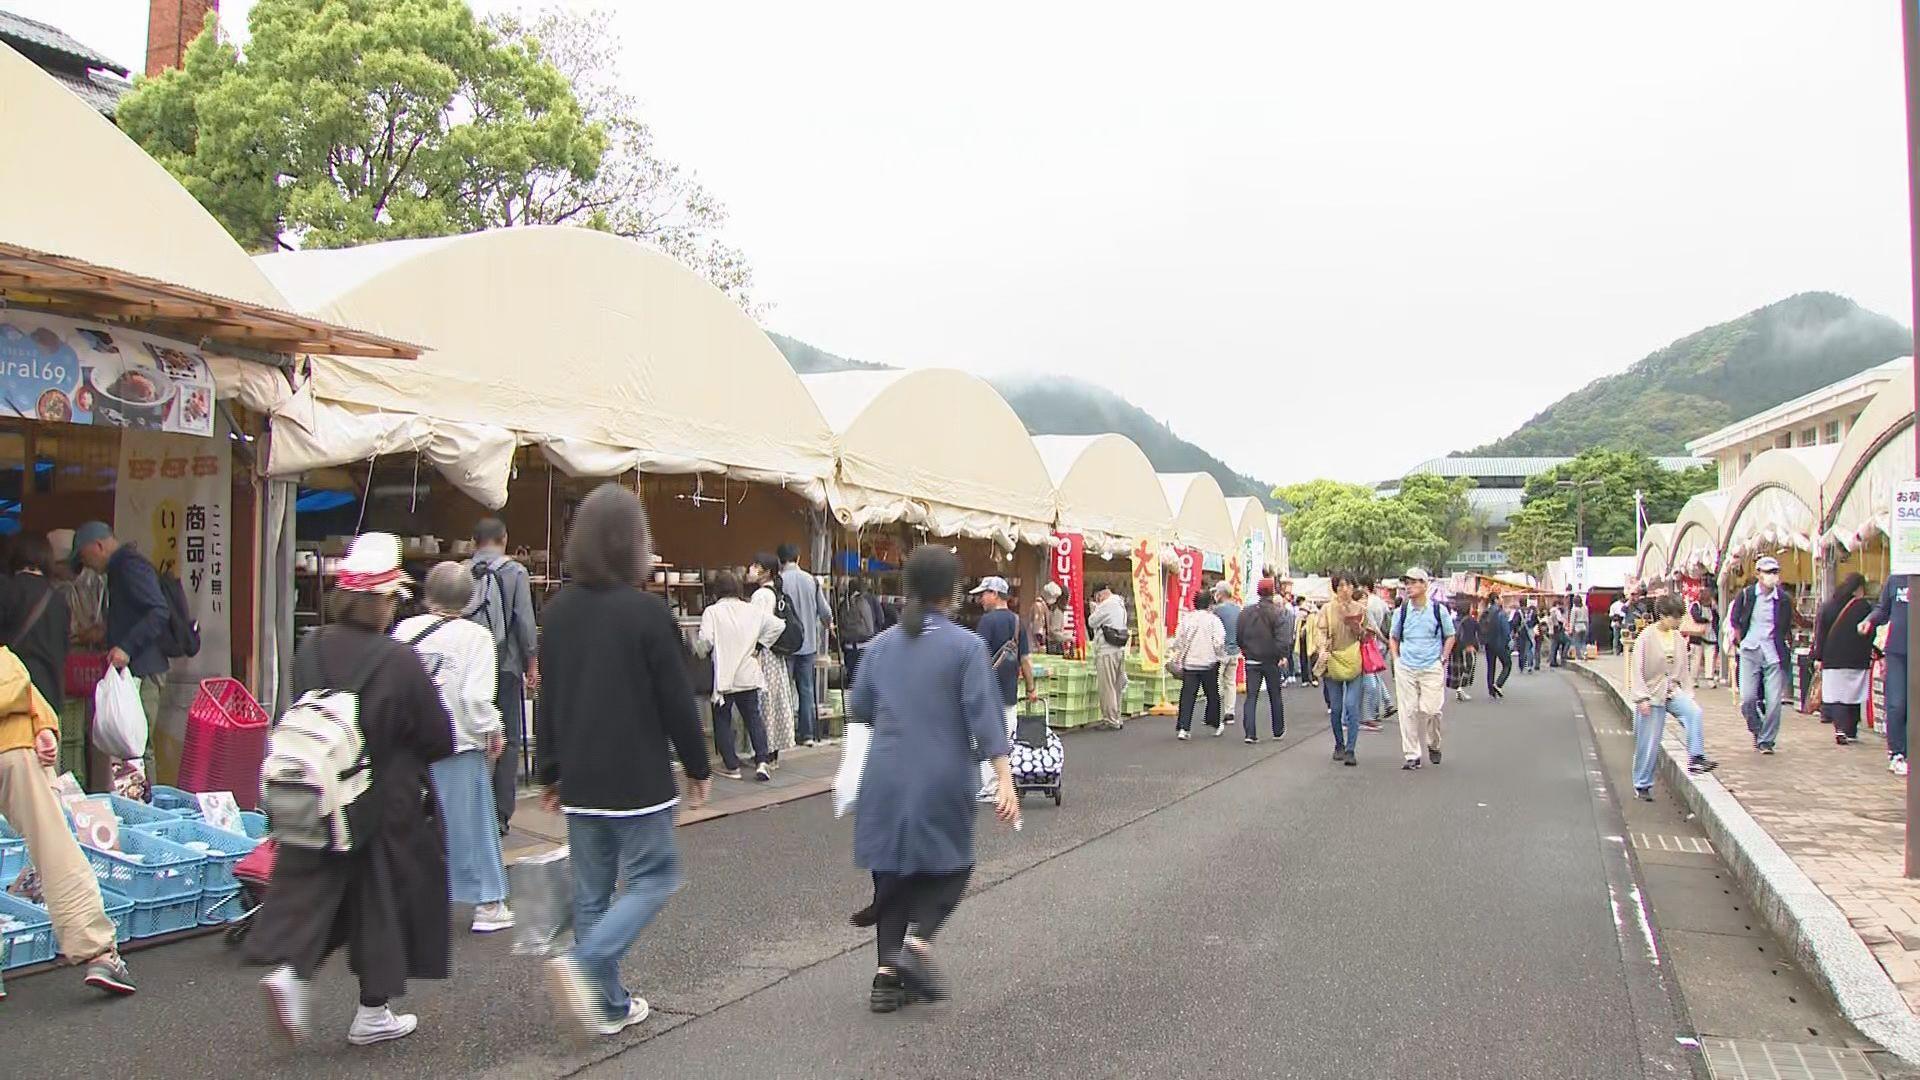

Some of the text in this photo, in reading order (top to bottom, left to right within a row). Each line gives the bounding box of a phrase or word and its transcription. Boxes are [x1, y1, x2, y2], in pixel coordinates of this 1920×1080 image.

[186, 504, 205, 593] 商品が
[211, 504, 222, 614] ここには無い
